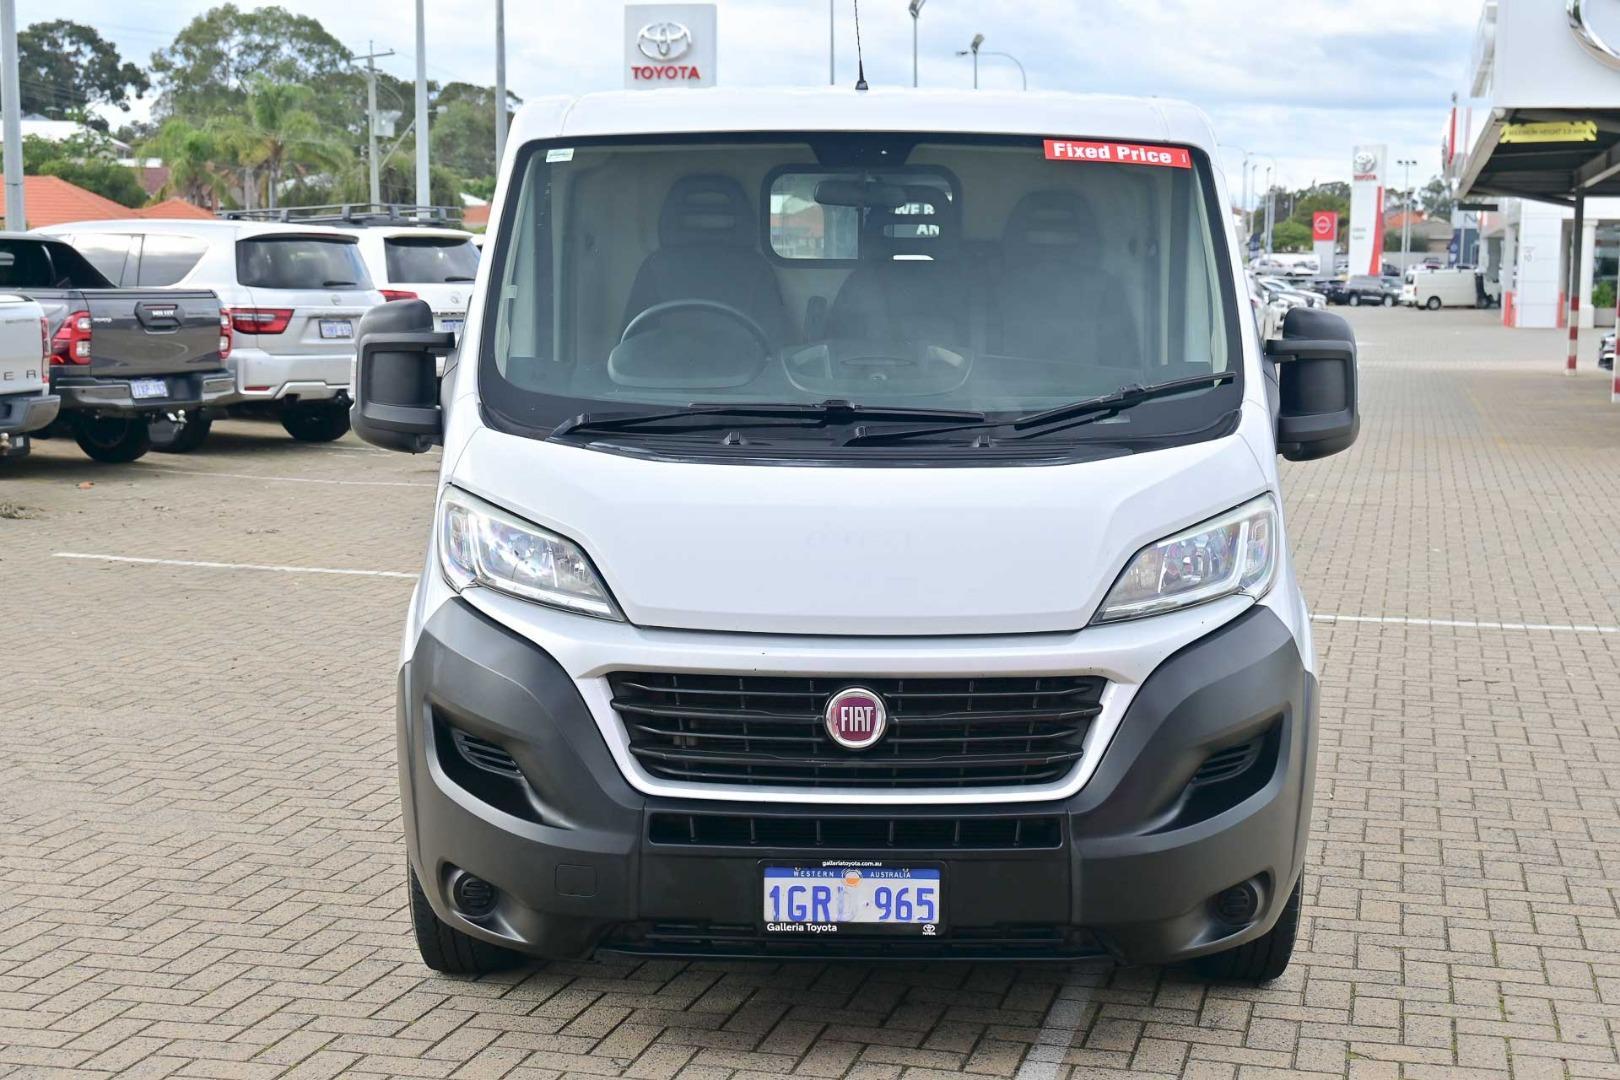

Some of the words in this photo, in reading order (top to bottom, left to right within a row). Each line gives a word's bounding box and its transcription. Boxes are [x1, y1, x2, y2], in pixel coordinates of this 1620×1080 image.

[631, 66, 701, 80] TOYOTA
[1053, 142, 1111, 160] Fixed
[1117, 146, 1173, 164] Price
[841, 706, 874, 732] FIAT
[874, 886, 935, 921] 965
[766, 923, 804, 932] Galleria
[806, 923, 838, 934] Toyota
